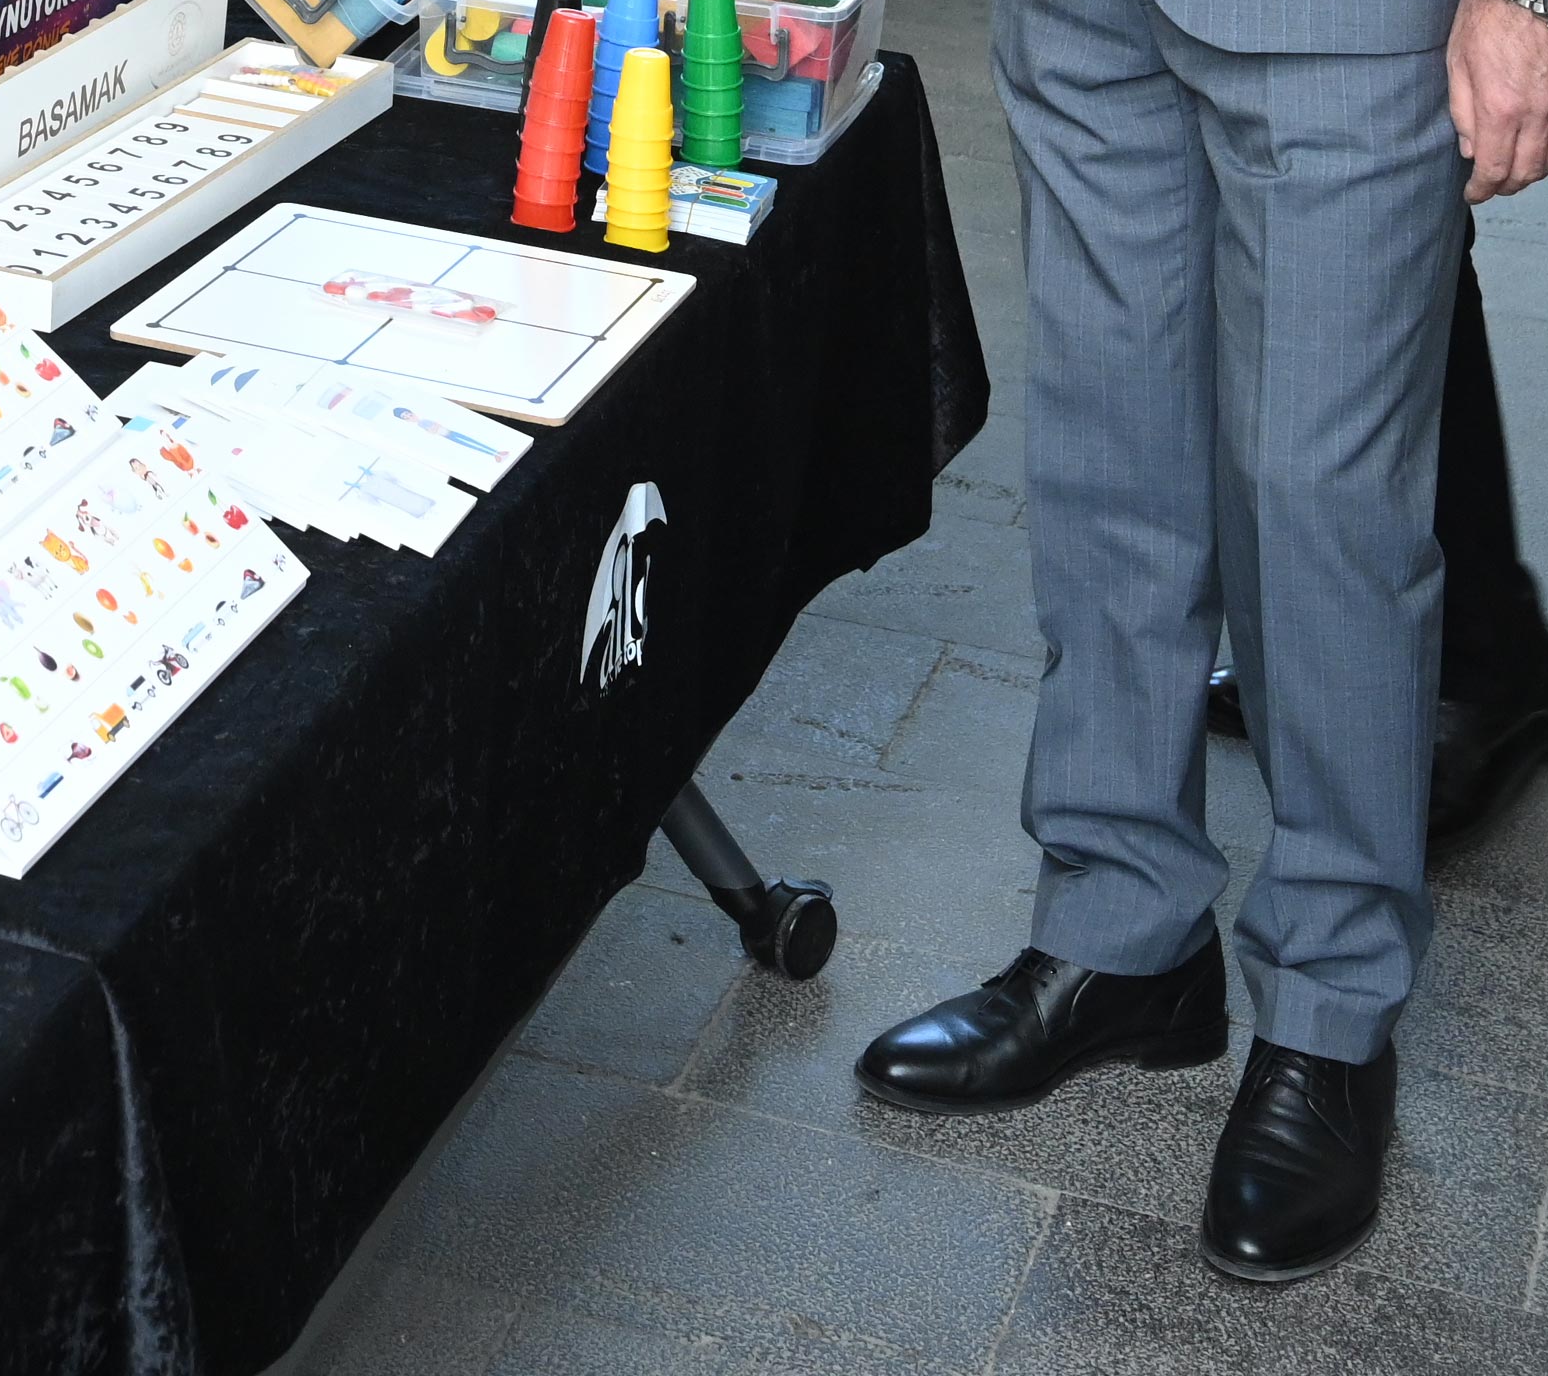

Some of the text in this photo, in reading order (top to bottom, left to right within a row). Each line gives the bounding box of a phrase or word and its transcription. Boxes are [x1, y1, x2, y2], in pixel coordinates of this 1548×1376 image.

[17, 59, 129, 159] BASAMAK
[14, 204, 51, 216] 3
[42, 189, 76, 201] 4
[62, 174, 99, 187] 5
[87, 161, 123, 172] 6
[108, 147, 143, 159] 7
[132, 135, 168, 146] 8
[154, 122, 189, 133] 9
[32, 248, 68, 258] 1
[55, 232, 96, 246] 2
[80, 217, 118, 229] 3
[108, 202, 143, 214] 4
[128, 187, 166, 200] 5
[152, 174, 188, 185] 6
[172, 159, 208, 171] 7
[196, 147, 232, 158] 8
[217, 134, 253, 145] 9
